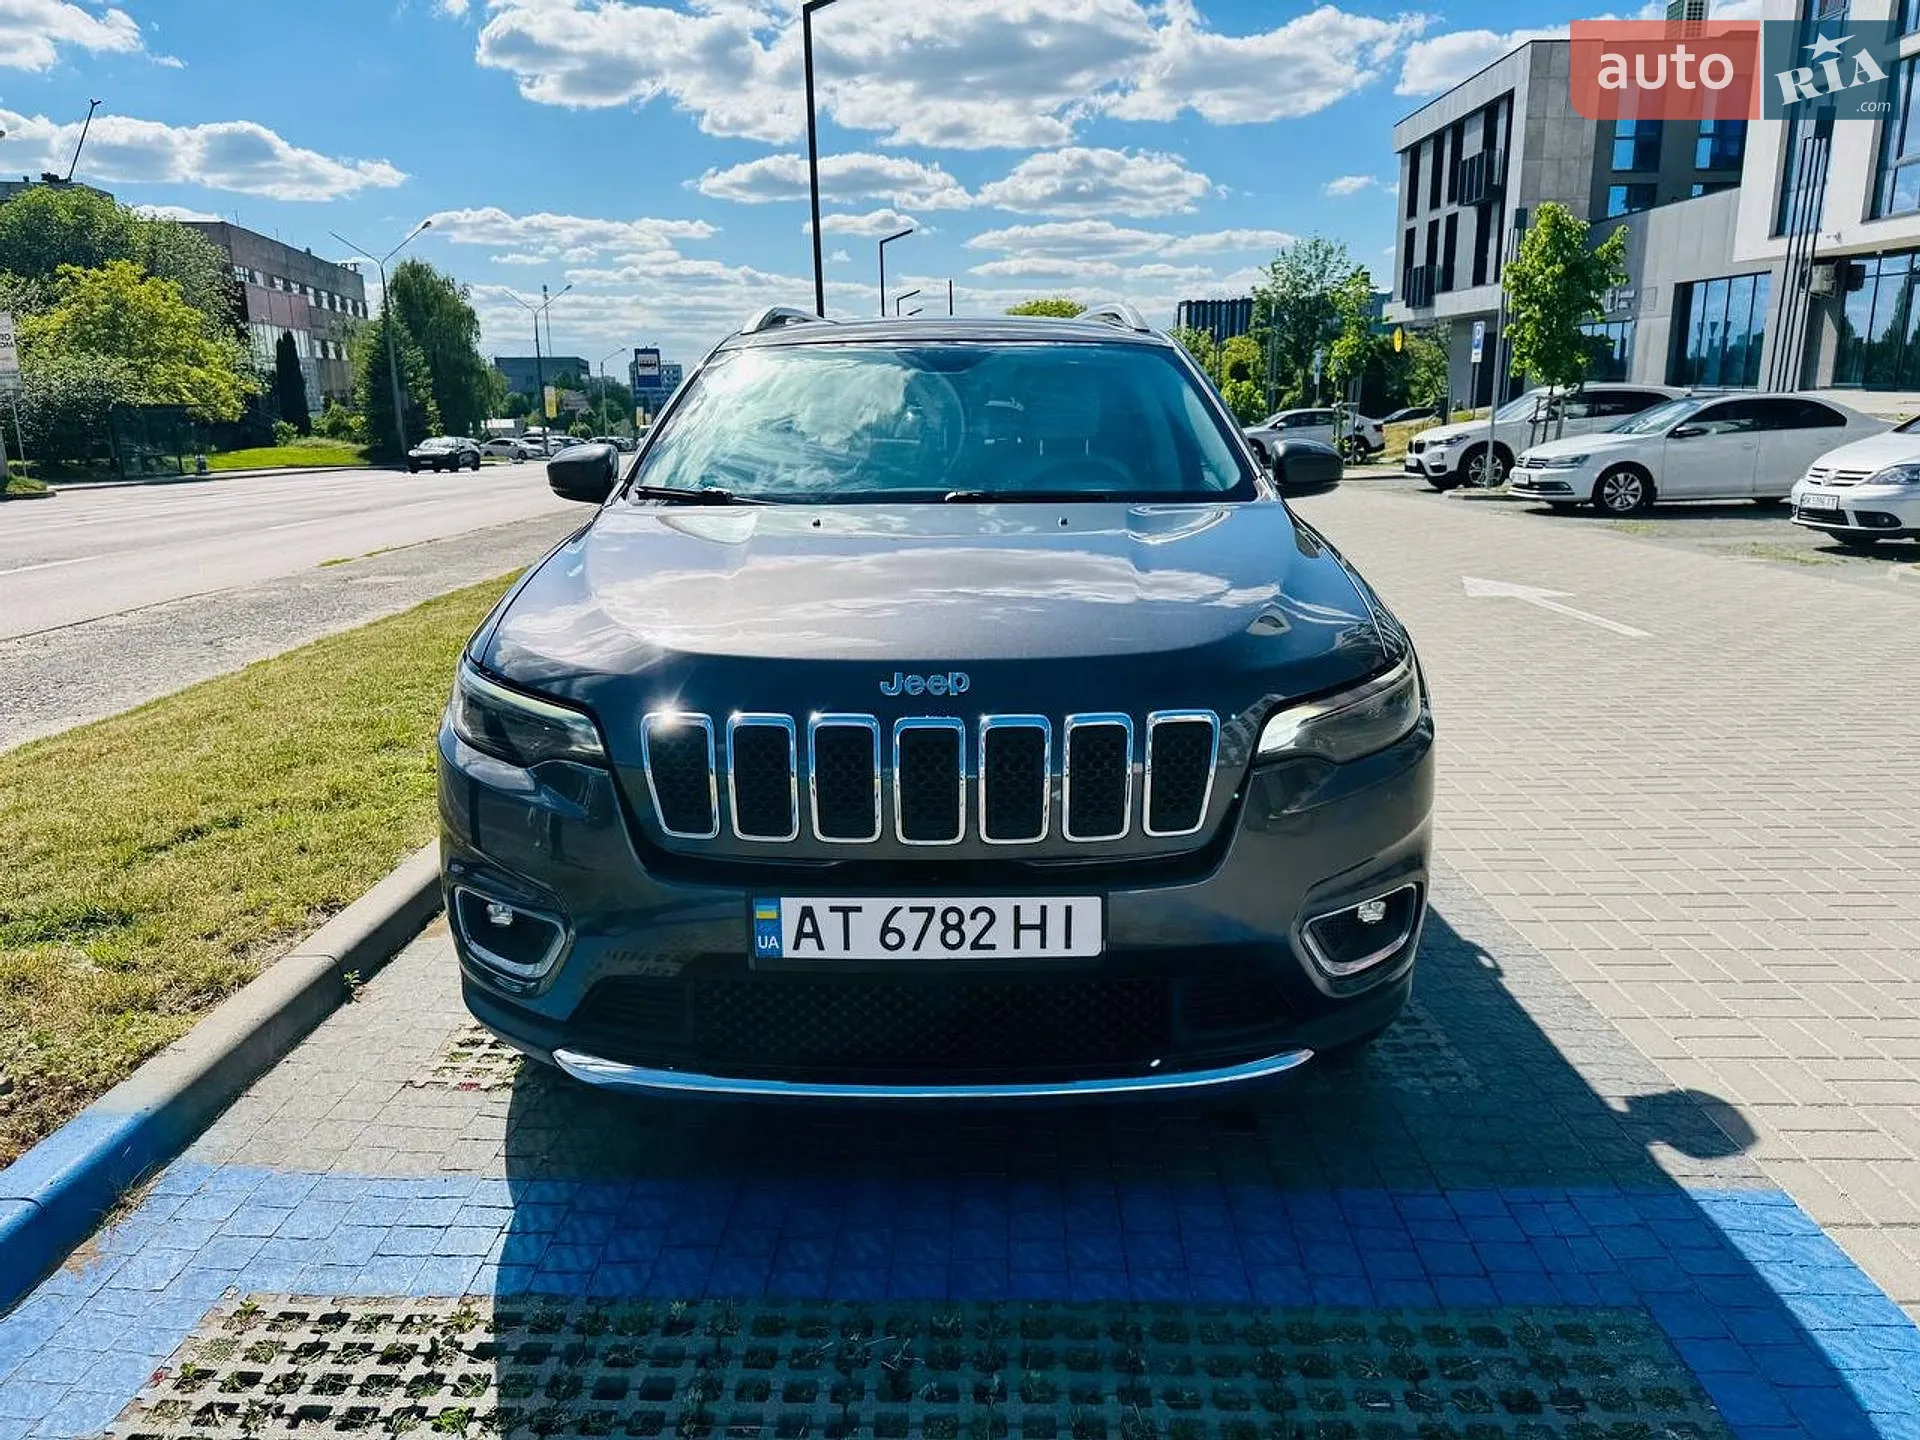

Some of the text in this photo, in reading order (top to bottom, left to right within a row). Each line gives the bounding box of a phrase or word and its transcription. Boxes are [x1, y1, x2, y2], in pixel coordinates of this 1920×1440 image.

[880, 671, 971, 696] Jeep
[792, 904, 1073, 951] AT 6782 HI
[757, 934, 779, 949] UA
